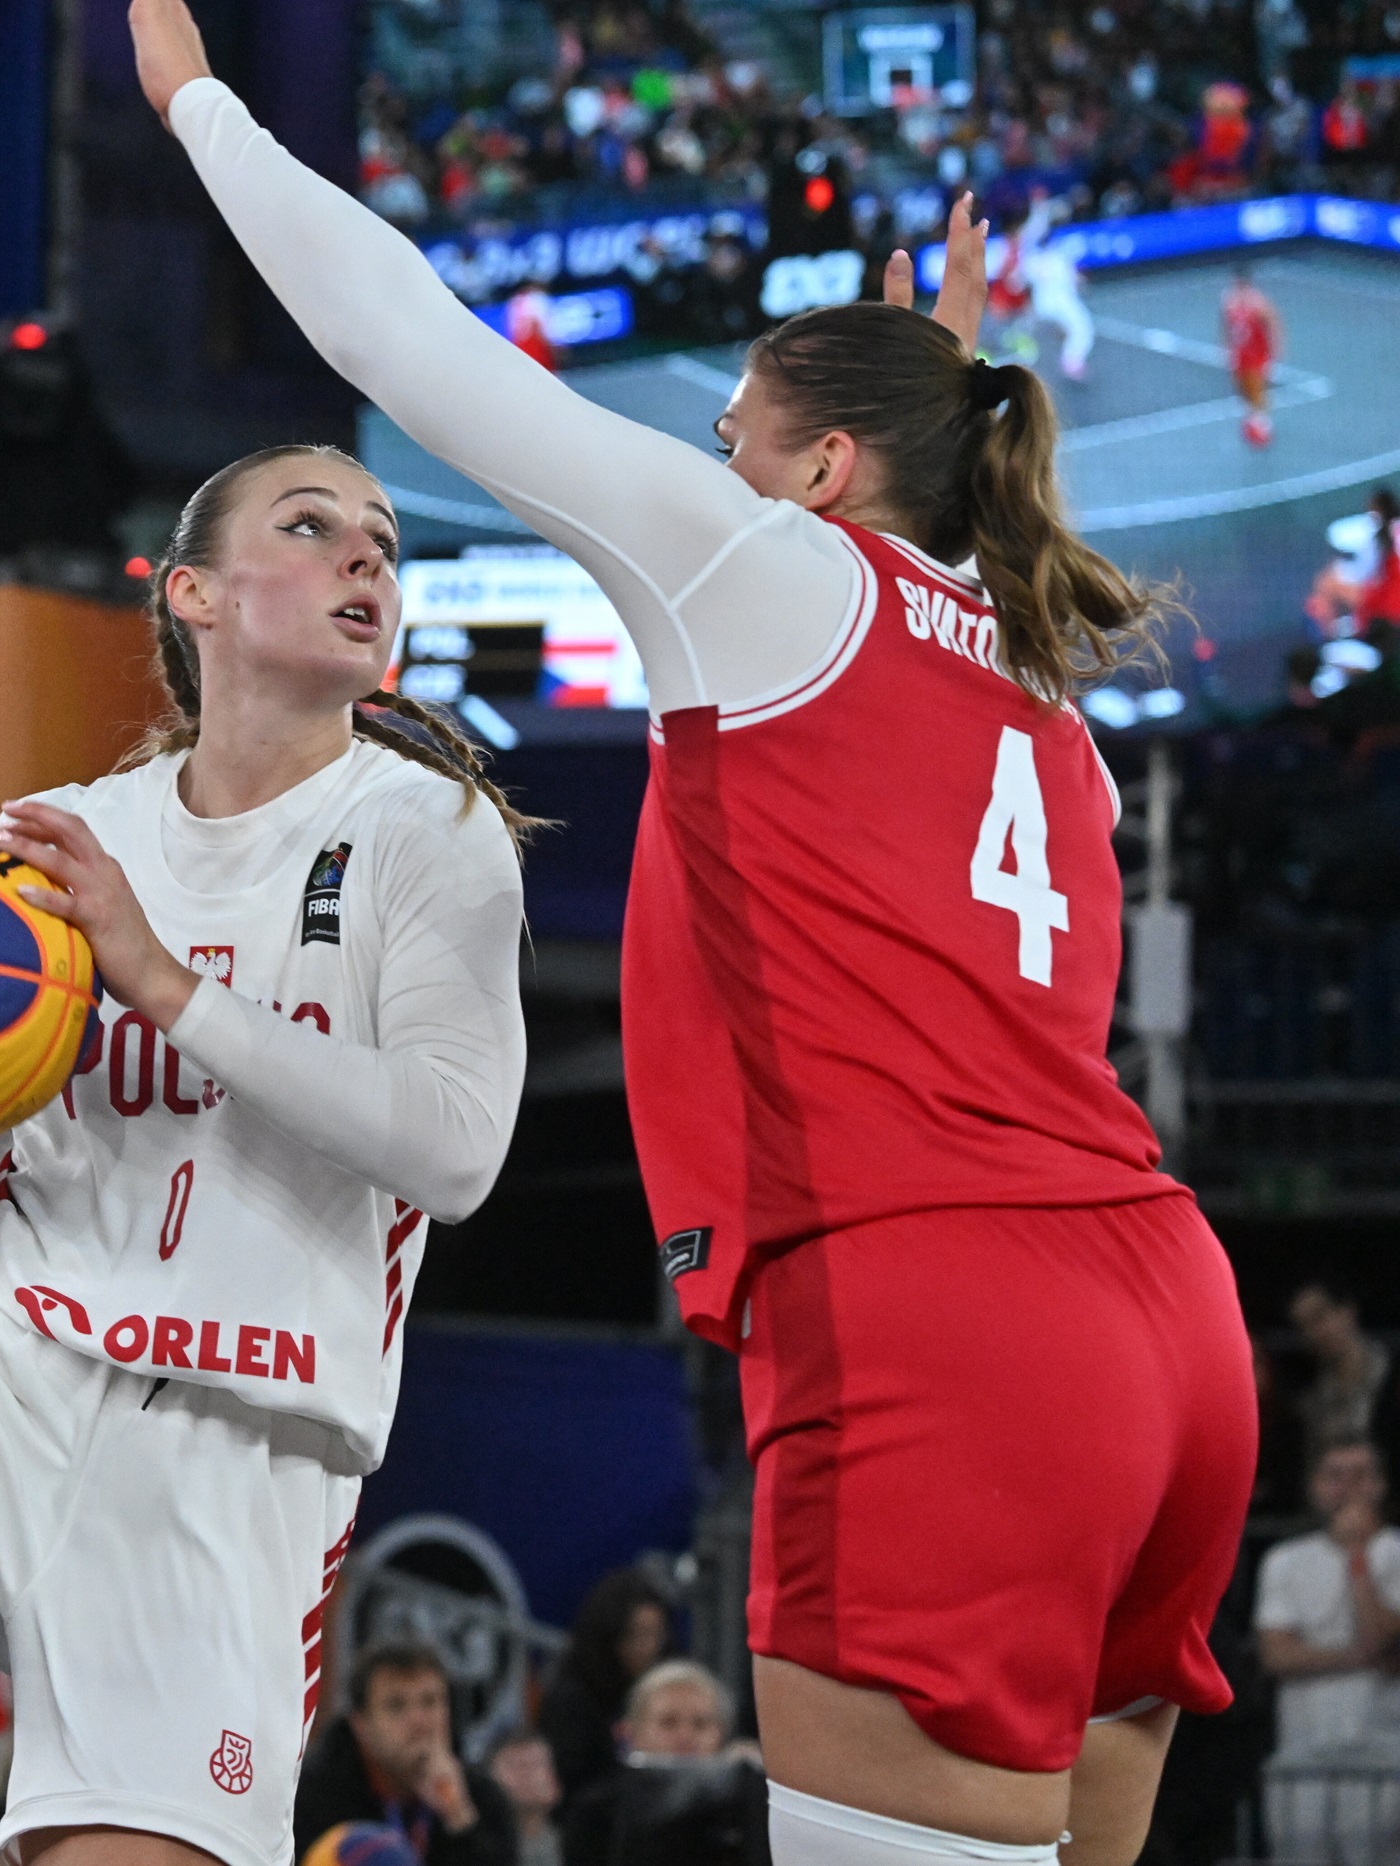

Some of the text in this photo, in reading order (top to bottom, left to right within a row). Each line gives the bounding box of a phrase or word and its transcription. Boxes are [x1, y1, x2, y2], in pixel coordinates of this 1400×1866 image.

[970, 725, 1070, 988] 4
[307, 898, 340, 917] FIBA
[158, 1158, 195, 1262] 0
[103, 1314, 316, 1385] ORLEN
